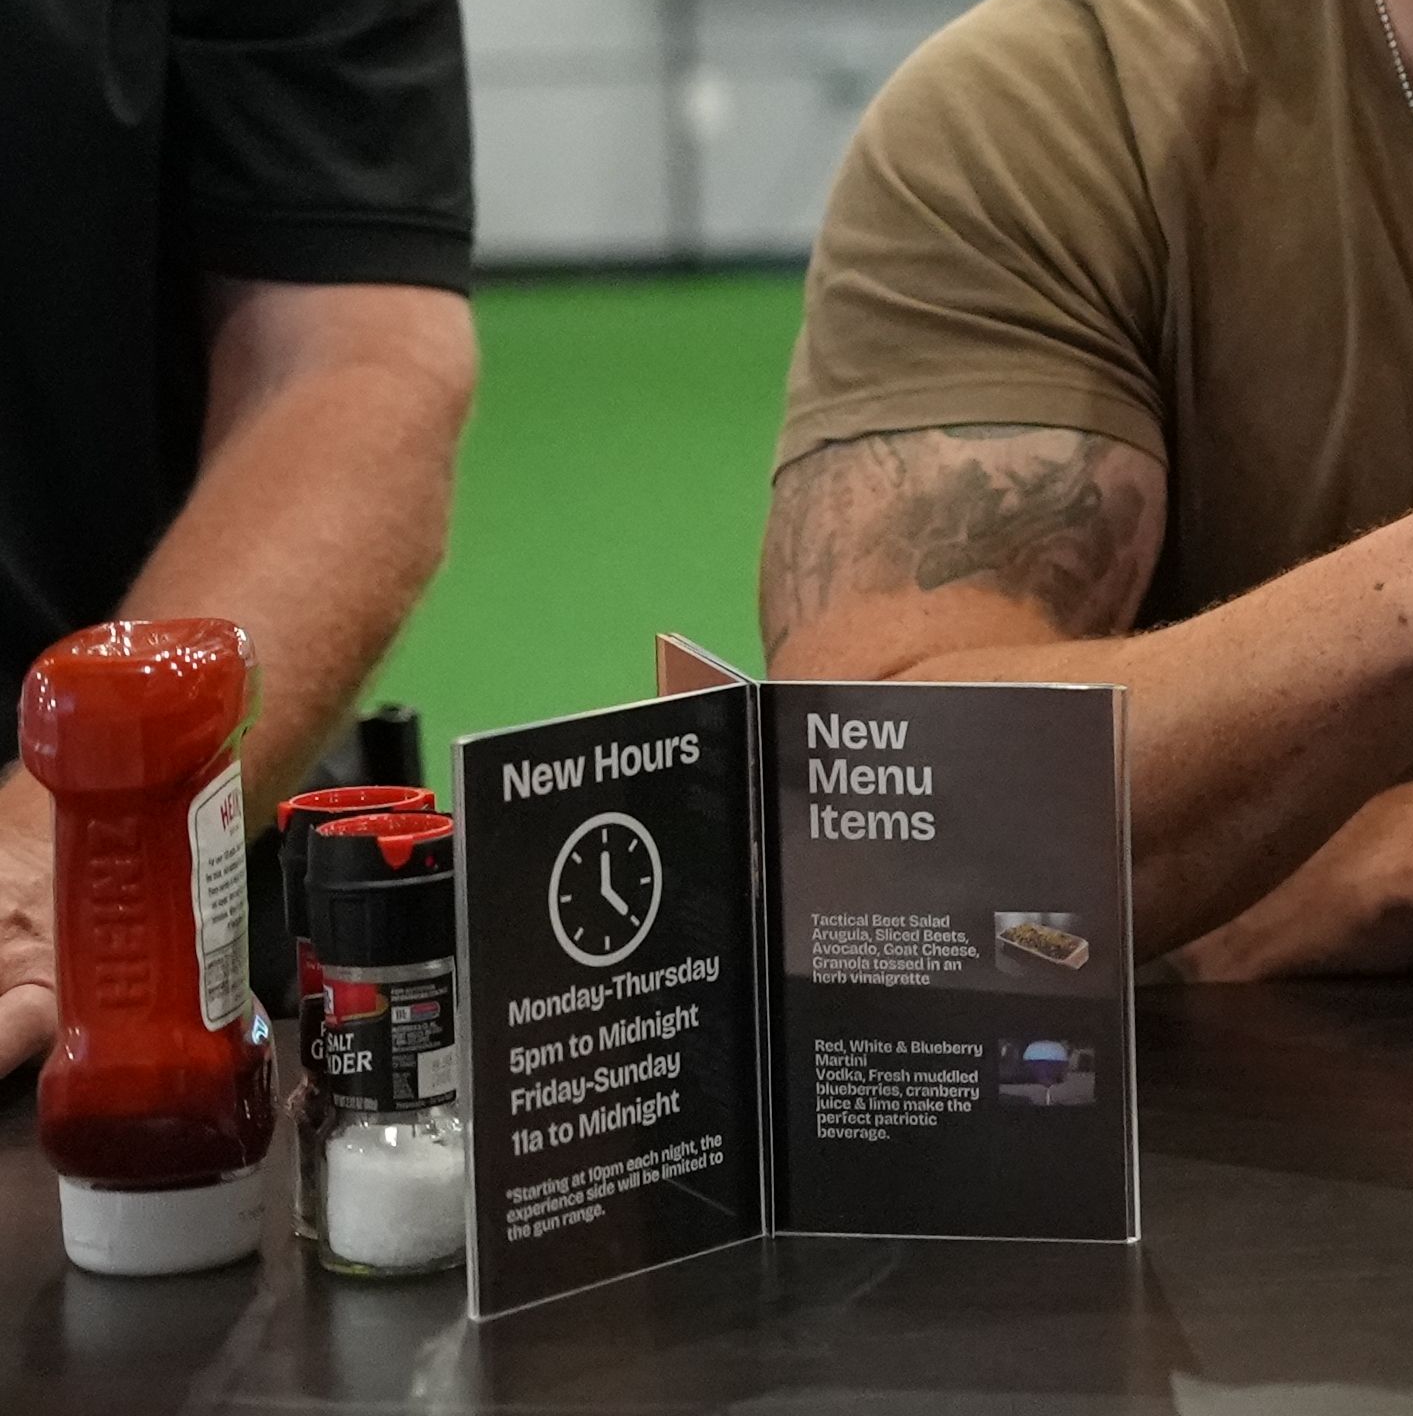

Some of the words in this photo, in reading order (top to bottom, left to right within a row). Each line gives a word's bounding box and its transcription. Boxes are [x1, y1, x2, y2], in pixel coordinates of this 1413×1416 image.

[806, 712, 909, 750] New
[503, 755, 586, 802] New
[594, 733, 701, 783] Hours
[808, 758, 933, 795] Menu
[809, 803, 936, 841] Items
[811, 913, 869, 927] Tactical
[872, 914, 906, 927] Beet
[909, 914, 950, 928] Salad
[811, 928, 873, 944] Arugula,
[875, 929, 920, 942] Sliced
[923, 930, 969, 944] Beets,
[812, 942, 881, 957] Avocado,
[884, 943, 919, 956] Goat
[922, 943, 980, 959] Cheese,
[812, 956, 870, 970] Granola
[873, 957, 924, 971] tossed
[927, 957, 940, 971] in
[943, 960, 962, 971] an
[812, 970, 847, 984] herb
[850, 971, 931, 987] vinaigrette
[508, 955, 720, 1027] Monday-Thursday
[327, 1032, 355, 1052] SALT
[509, 1041, 563, 1075] 5pm
[568, 1033, 594, 1058] to
[599, 1003, 699, 1051] Midnight
[815, 1039, 847, 1054] Red,
[850, 1039, 893, 1053] White
[895, 1041, 908, 1053] &
[911, 1041, 983, 1058] Blueberry
[815, 1053, 868, 1067] Martini
[510, 1051, 681, 1116] Friday-Sunday
[815, 1068, 866, 1083] Vodka,
[868, 1069, 911, 1082] Fresh
[913, 1070, 979, 1083] muddled
[816, 1082, 903, 1098] blueberries,
[905, 1084, 980, 1100] cranberry
[816, 1096, 851, 1112] juice
[854, 1097, 866, 1110] &
[869, 1097, 900, 1111] lime
[903, 1098, 945, 1112] make
[947, 1099, 972, 1112] the
[511, 1129, 544, 1156] 11a
[549, 1122, 574, 1147] to
[579, 1089, 681, 1139] Midnight
[817, 1111, 872, 1127] perfect
[874, 1112, 938, 1127] patriotic
[817, 1125, 890, 1142] beverage.
[571, 1171, 586, 1187] at
[588, 1161, 624, 1183] 10pm
[626, 1150, 659, 1172] each
[661, 1140, 699, 1162] night,
[700, 1134, 723, 1152] the
[506, 1189, 585, 1223] experience
[586, 1182, 616, 1202] side
[617, 1170, 641, 1192] will
[642, 1168, 660, 1185] be
[661, 1154, 708, 1180] limited
[709, 1151, 724, 1166] to
[507, 1223, 531, 1242] the
[532, 1215, 561, 1238] gun
[562, 1203, 606, 1226] range.
